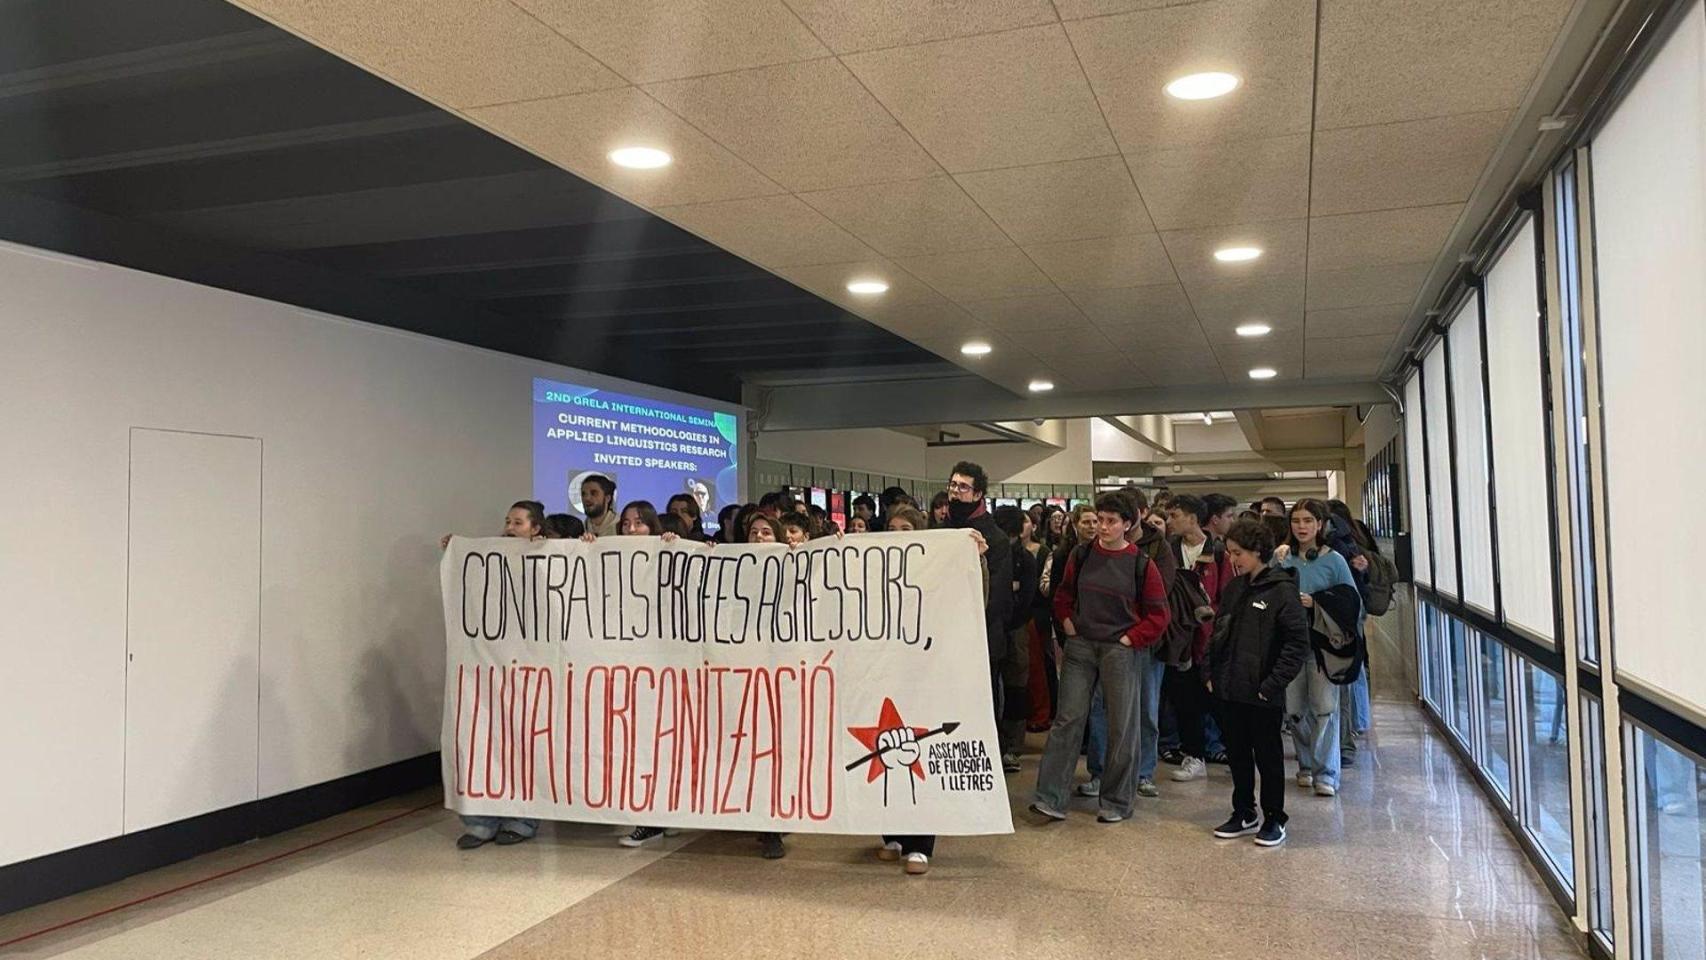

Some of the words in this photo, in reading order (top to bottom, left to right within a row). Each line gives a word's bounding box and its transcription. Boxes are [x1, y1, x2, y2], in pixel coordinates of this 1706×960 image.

[546, 391, 570, 403] 2ND
[573, 395, 609, 410] GRELA
[611, 402, 687, 423] INTERNATIONAL
[558, 412, 618, 430] CURRENT
[620, 422, 708, 443] METHODOLOGIES
[709, 435, 720, 445] IN
[546, 427, 604, 443] APPLIED
[606, 435, 678, 452] LINGUISTICS
[679, 444, 727, 458] RESEARCH
[594, 453, 642, 467] INVITED
[644, 457, 698, 472] SPEAKERS:
[462, 551, 594, 643] CONTRA
[601, 550, 651, 641] ELS
[657, 550, 757, 644] PROFES
[757, 543, 933, 651] AGRESSORS,
[928, 740, 987, 760] ASSEMBLEA
[928, 760, 941, 775] DE
[944, 756, 993, 774] FILOSOFIA
[941, 776, 946, 791] I
[949, 774, 994, 791] LLETRES
